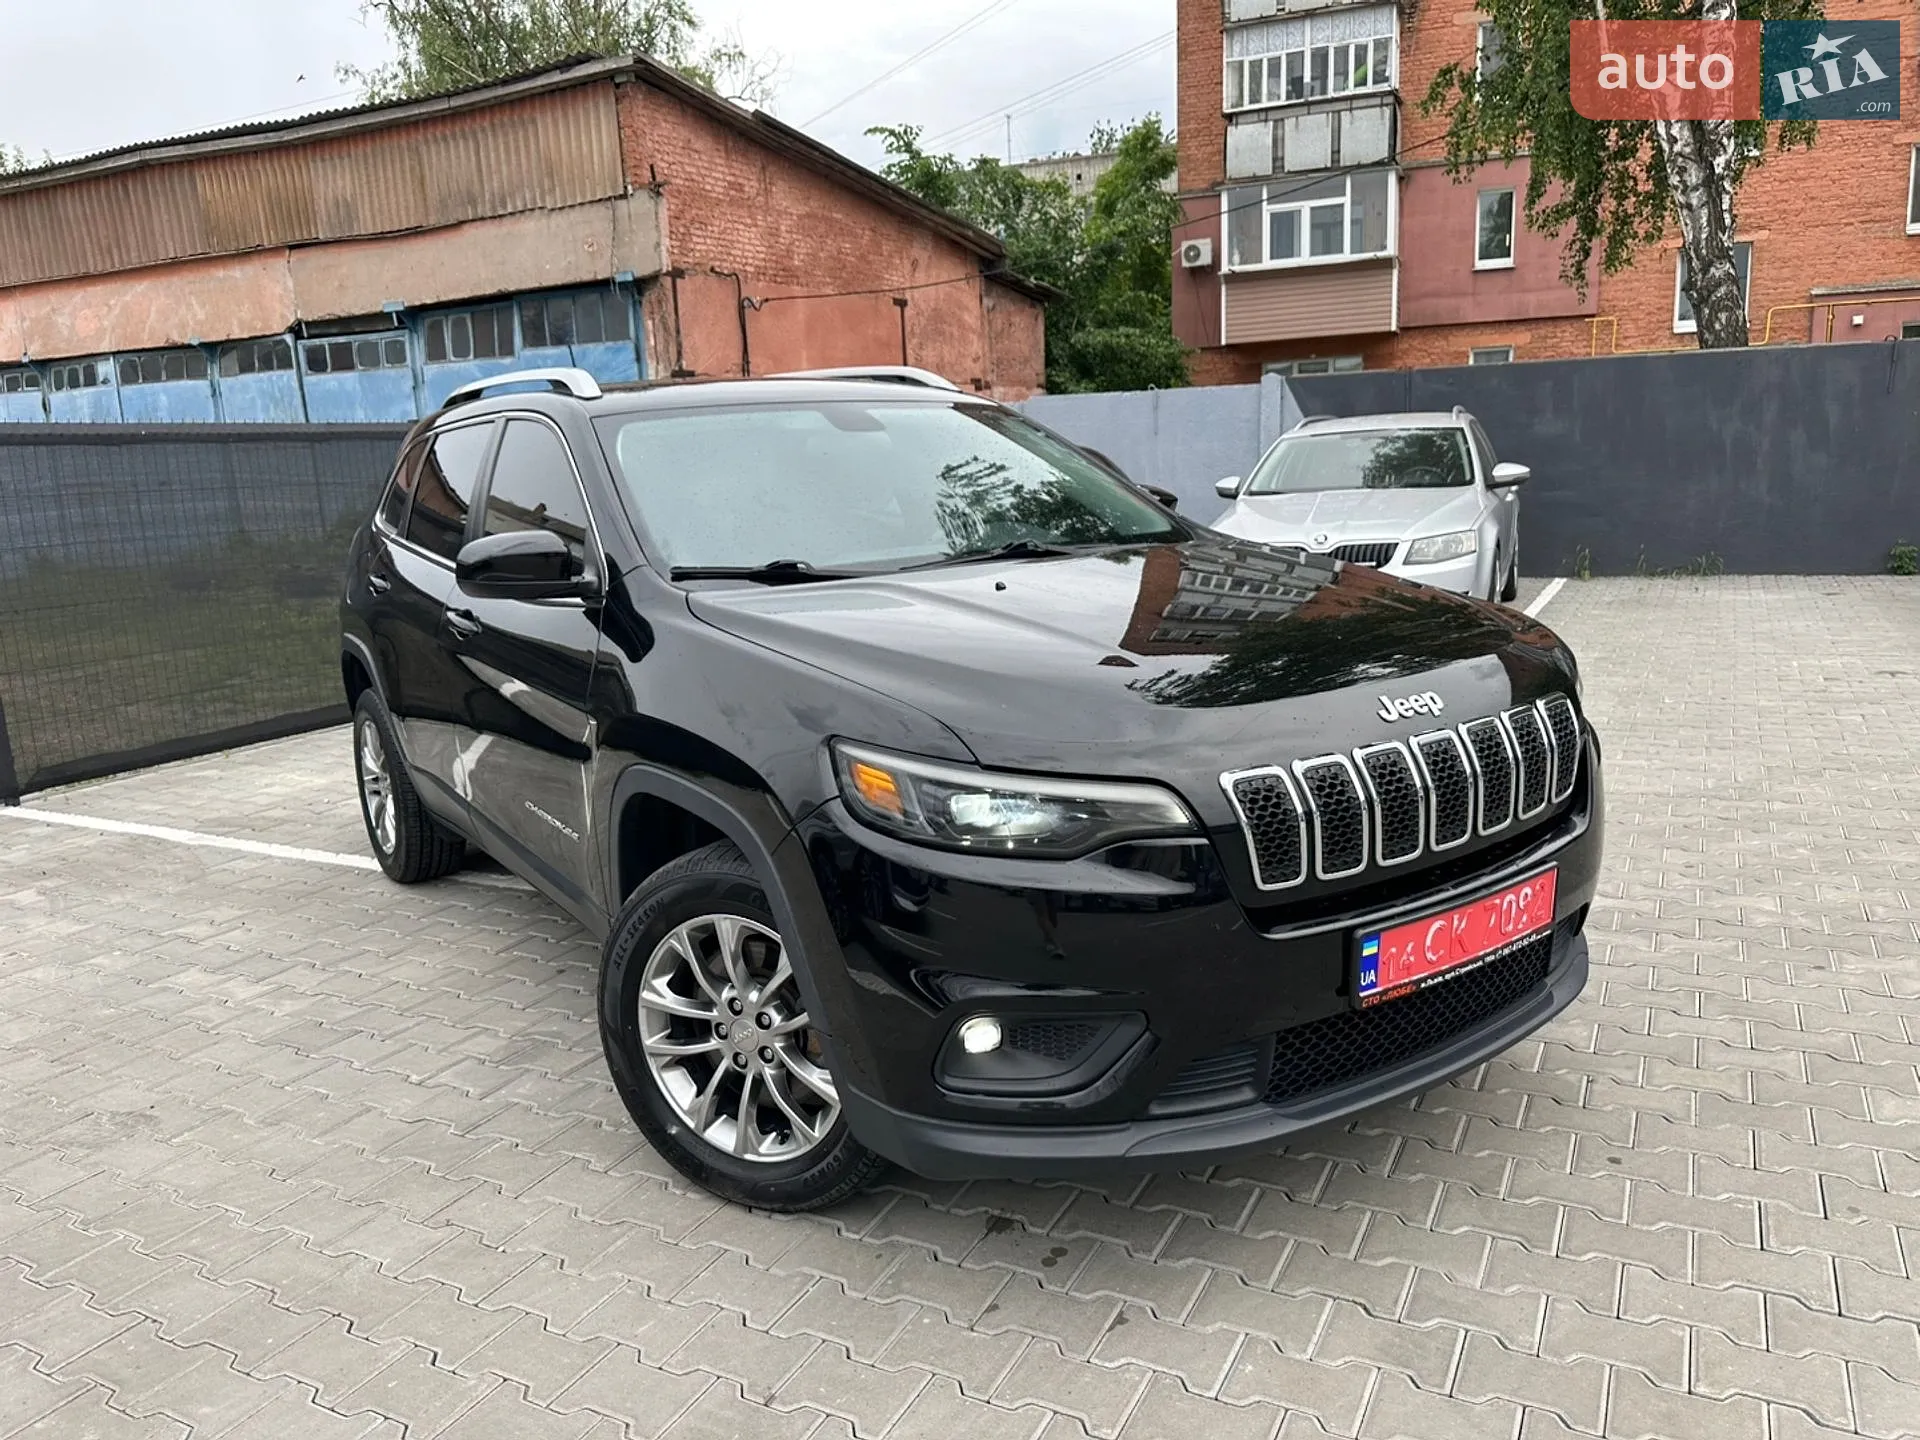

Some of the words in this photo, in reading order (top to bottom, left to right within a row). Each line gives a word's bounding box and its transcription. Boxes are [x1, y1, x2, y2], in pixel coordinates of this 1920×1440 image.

[1377, 691, 1444, 722] Jeep
[612, 897, 665, 970] ALL-SEASON
[1360, 969, 1376, 986] UA
